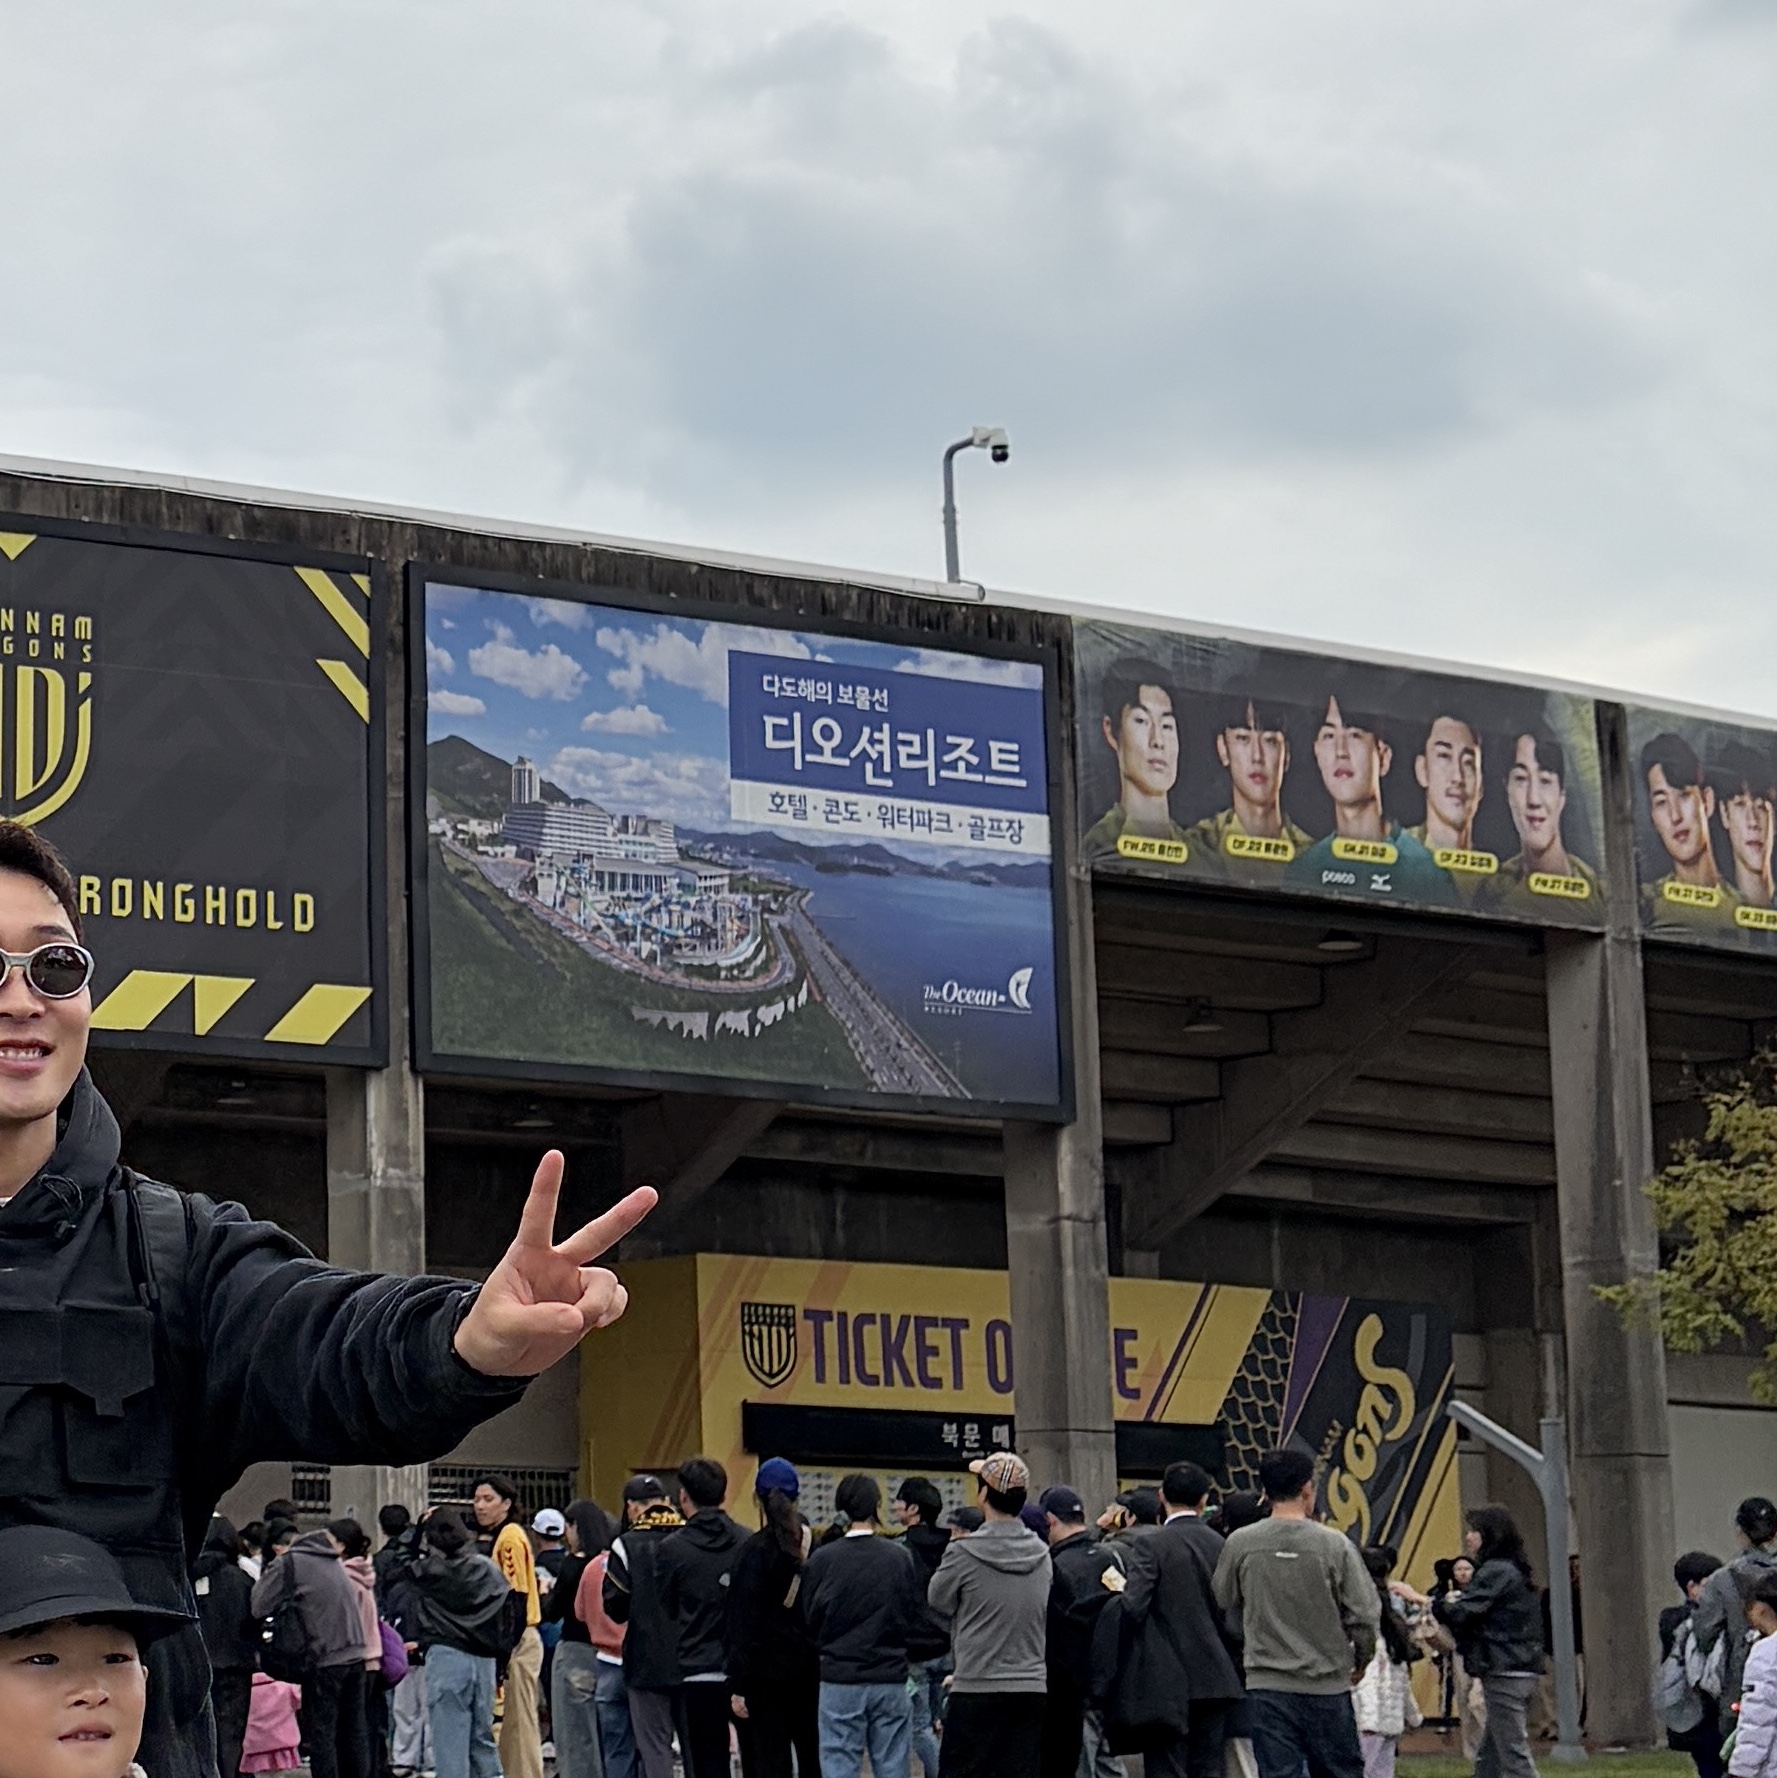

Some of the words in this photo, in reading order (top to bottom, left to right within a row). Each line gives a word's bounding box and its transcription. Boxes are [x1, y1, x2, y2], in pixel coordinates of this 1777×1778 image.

[762, 673, 832, 705] 다도해의
[836, 684, 888, 713] 보물선
[763, 711, 1028, 788] 디오션리조트
[768, 791, 808, 822] 호텔
[822, 798, 861, 825] 콘도
[877, 803, 953, 834] 워터파크
[967, 814, 1025, 846] 골프장
[79, 874, 316, 933] RONGHOLD
[803, 1308, 970, 1391] TICKET
[941, 1422, 981, 1448] 북문
